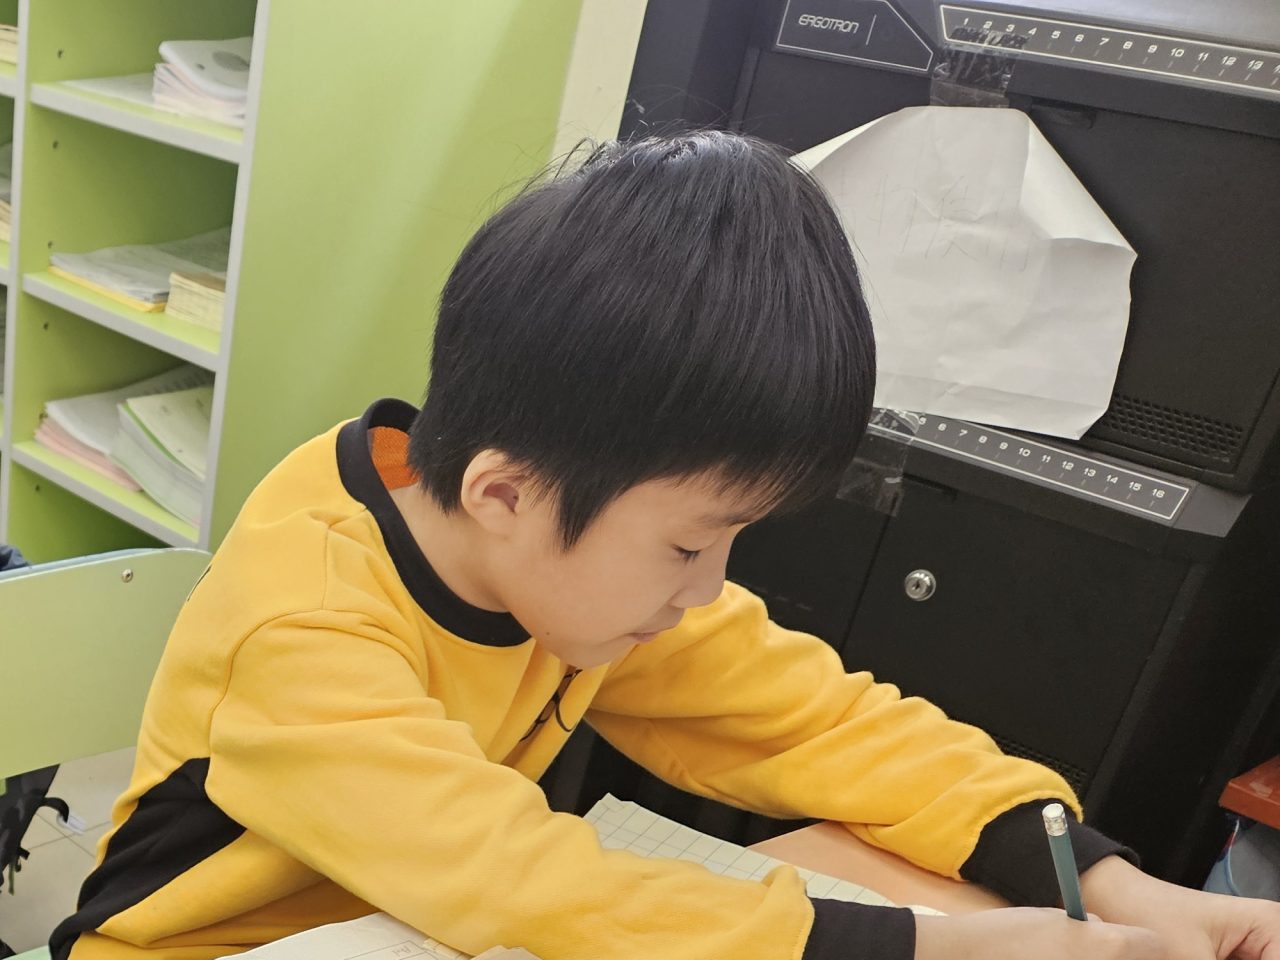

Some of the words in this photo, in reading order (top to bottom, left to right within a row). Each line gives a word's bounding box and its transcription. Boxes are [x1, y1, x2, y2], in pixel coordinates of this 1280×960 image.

[798, 14, 859, 34] ERGOTRON
[983, 20, 993, 29] 2
[1006, 24, 1016, 33] 3
[1028, 27, 1037, 36] 4
[1051, 30, 1061, 39] 5
[1075, 34, 1084, 43] 6
[1099, 37, 1109, 46] 7
[1123, 41, 1133, 50] 8
[1148, 44, 1158, 53] 9
[1170, 48, 1185, 58] 10
[1198, 52, 1210, 62] 11
[1222, 56, 1238, 67] 12
[1248, 60, 1264, 71] 13
[919, 416, 927, 425] 5
[938, 423, 947, 432] 6
[959, 429, 968, 437] 7
[978, 435, 988, 444] 8
[999, 442, 1008, 450] 9
[1018, 447, 1031, 457] 10
[1041, 454, 1051, 463] 11
[1062, 460, 1074, 470] 12
[1083, 467, 1096, 477] 13
[1105, 474, 1118, 484] 14
[1128, 481, 1142, 491] 15
[1152, 488, 1165, 498] 16
